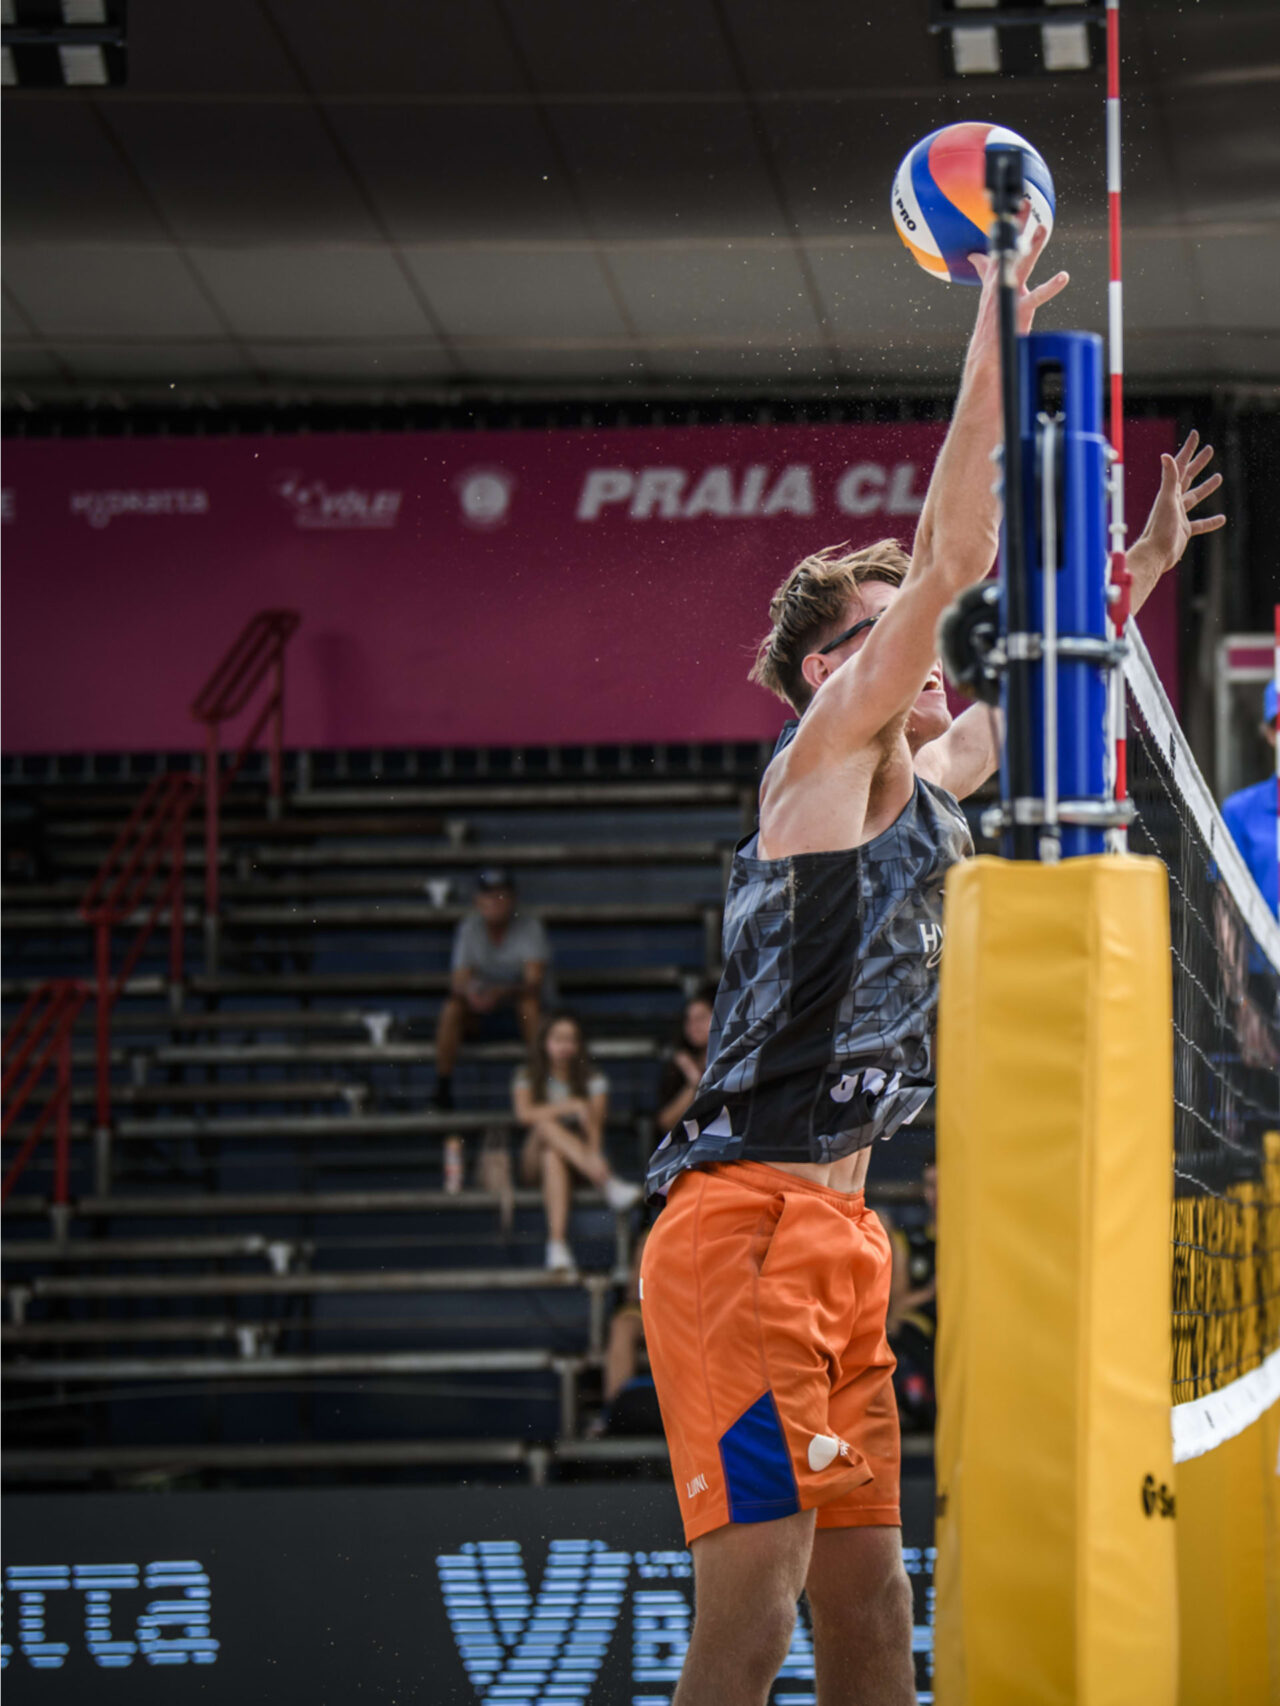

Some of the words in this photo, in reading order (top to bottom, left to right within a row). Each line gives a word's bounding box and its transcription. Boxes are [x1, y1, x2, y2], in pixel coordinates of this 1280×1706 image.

[896, 197, 917, 231] PRO
[577, 464, 814, 520] PRAIA
[836, 462, 927, 515] CL
